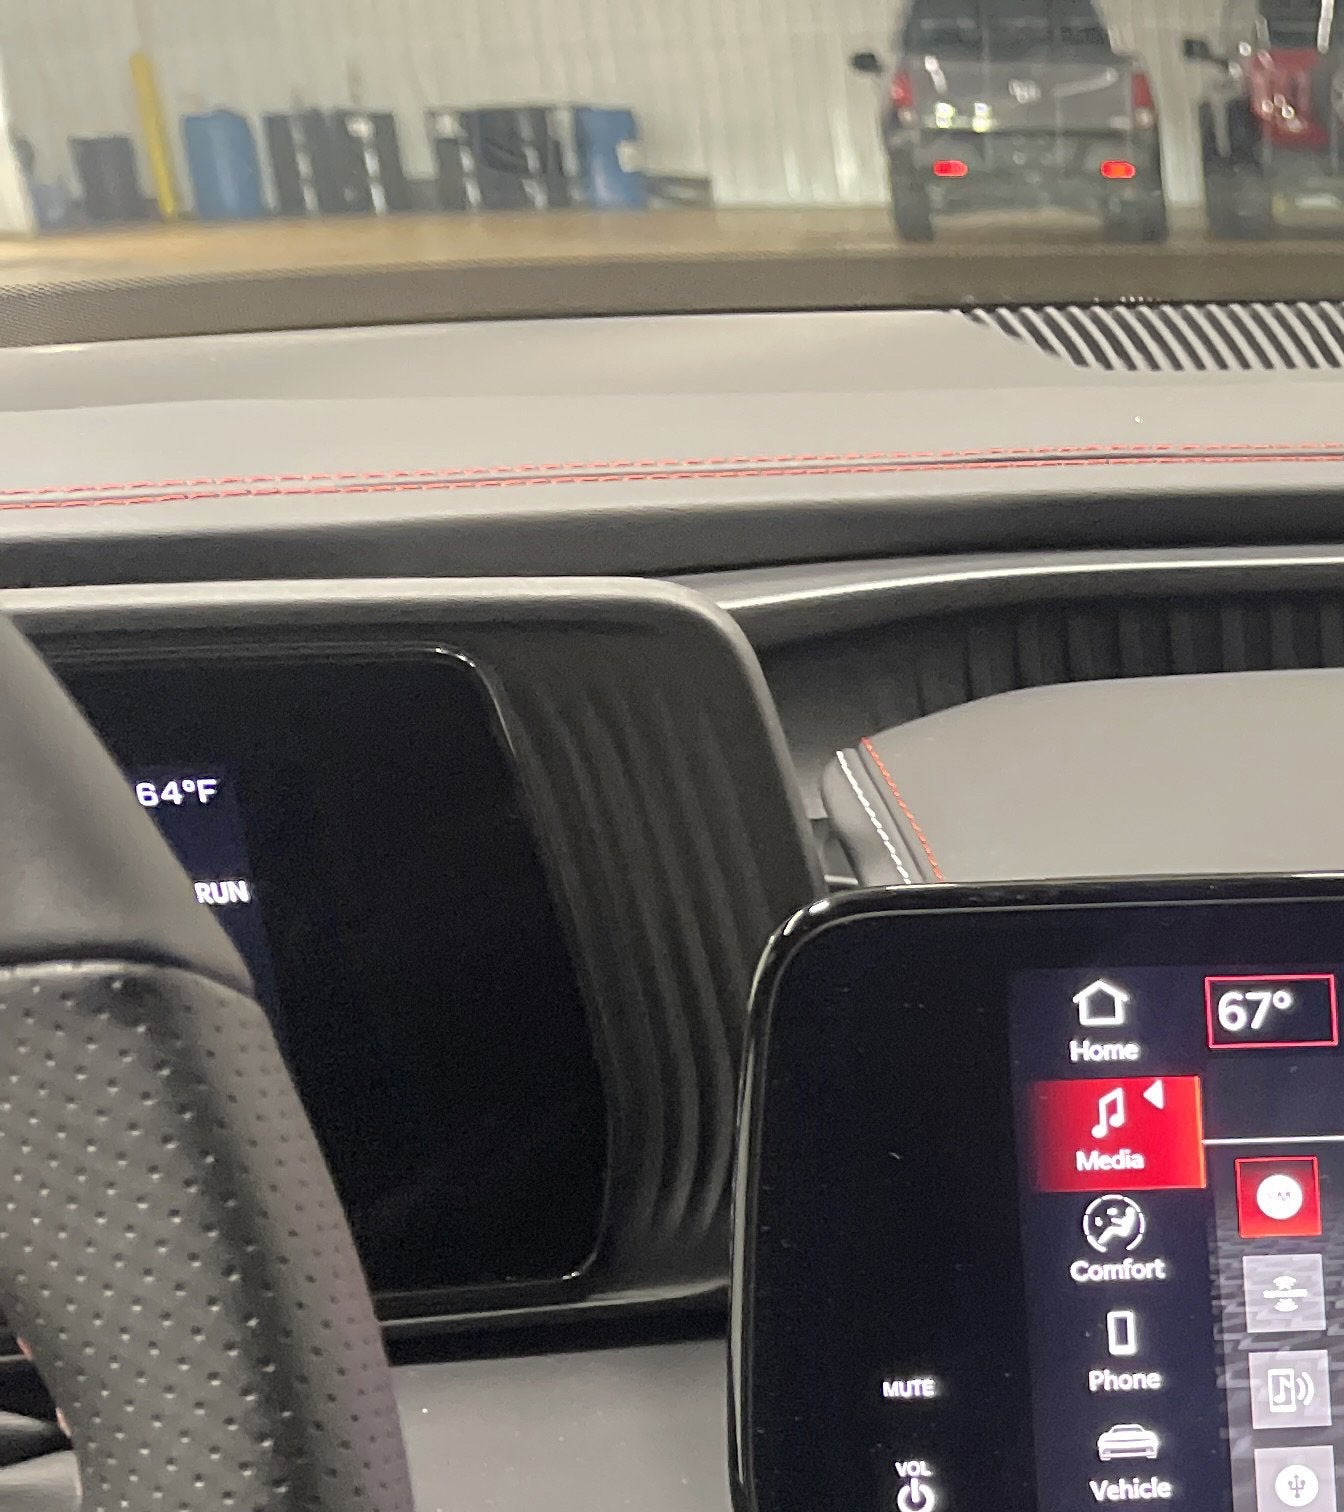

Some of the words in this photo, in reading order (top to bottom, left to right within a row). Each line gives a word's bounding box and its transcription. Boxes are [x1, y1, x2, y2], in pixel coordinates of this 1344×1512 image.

[135, 777, 218, 807] 64°F
[194, 879, 250, 904] RUN
[1216, 989, 1295, 1032] 67°
[1069, 1039, 1140, 1063] Home
[1075, 1149, 1145, 1172] Media
[1069, 1257, 1166, 1283] Comfort
[882, 1376, 937, 1399] MUTE
[1087, 1369, 1163, 1393] Phone
[895, 1461, 933, 1477] VOL
[1088, 1476, 1173, 1502] Vehicle
